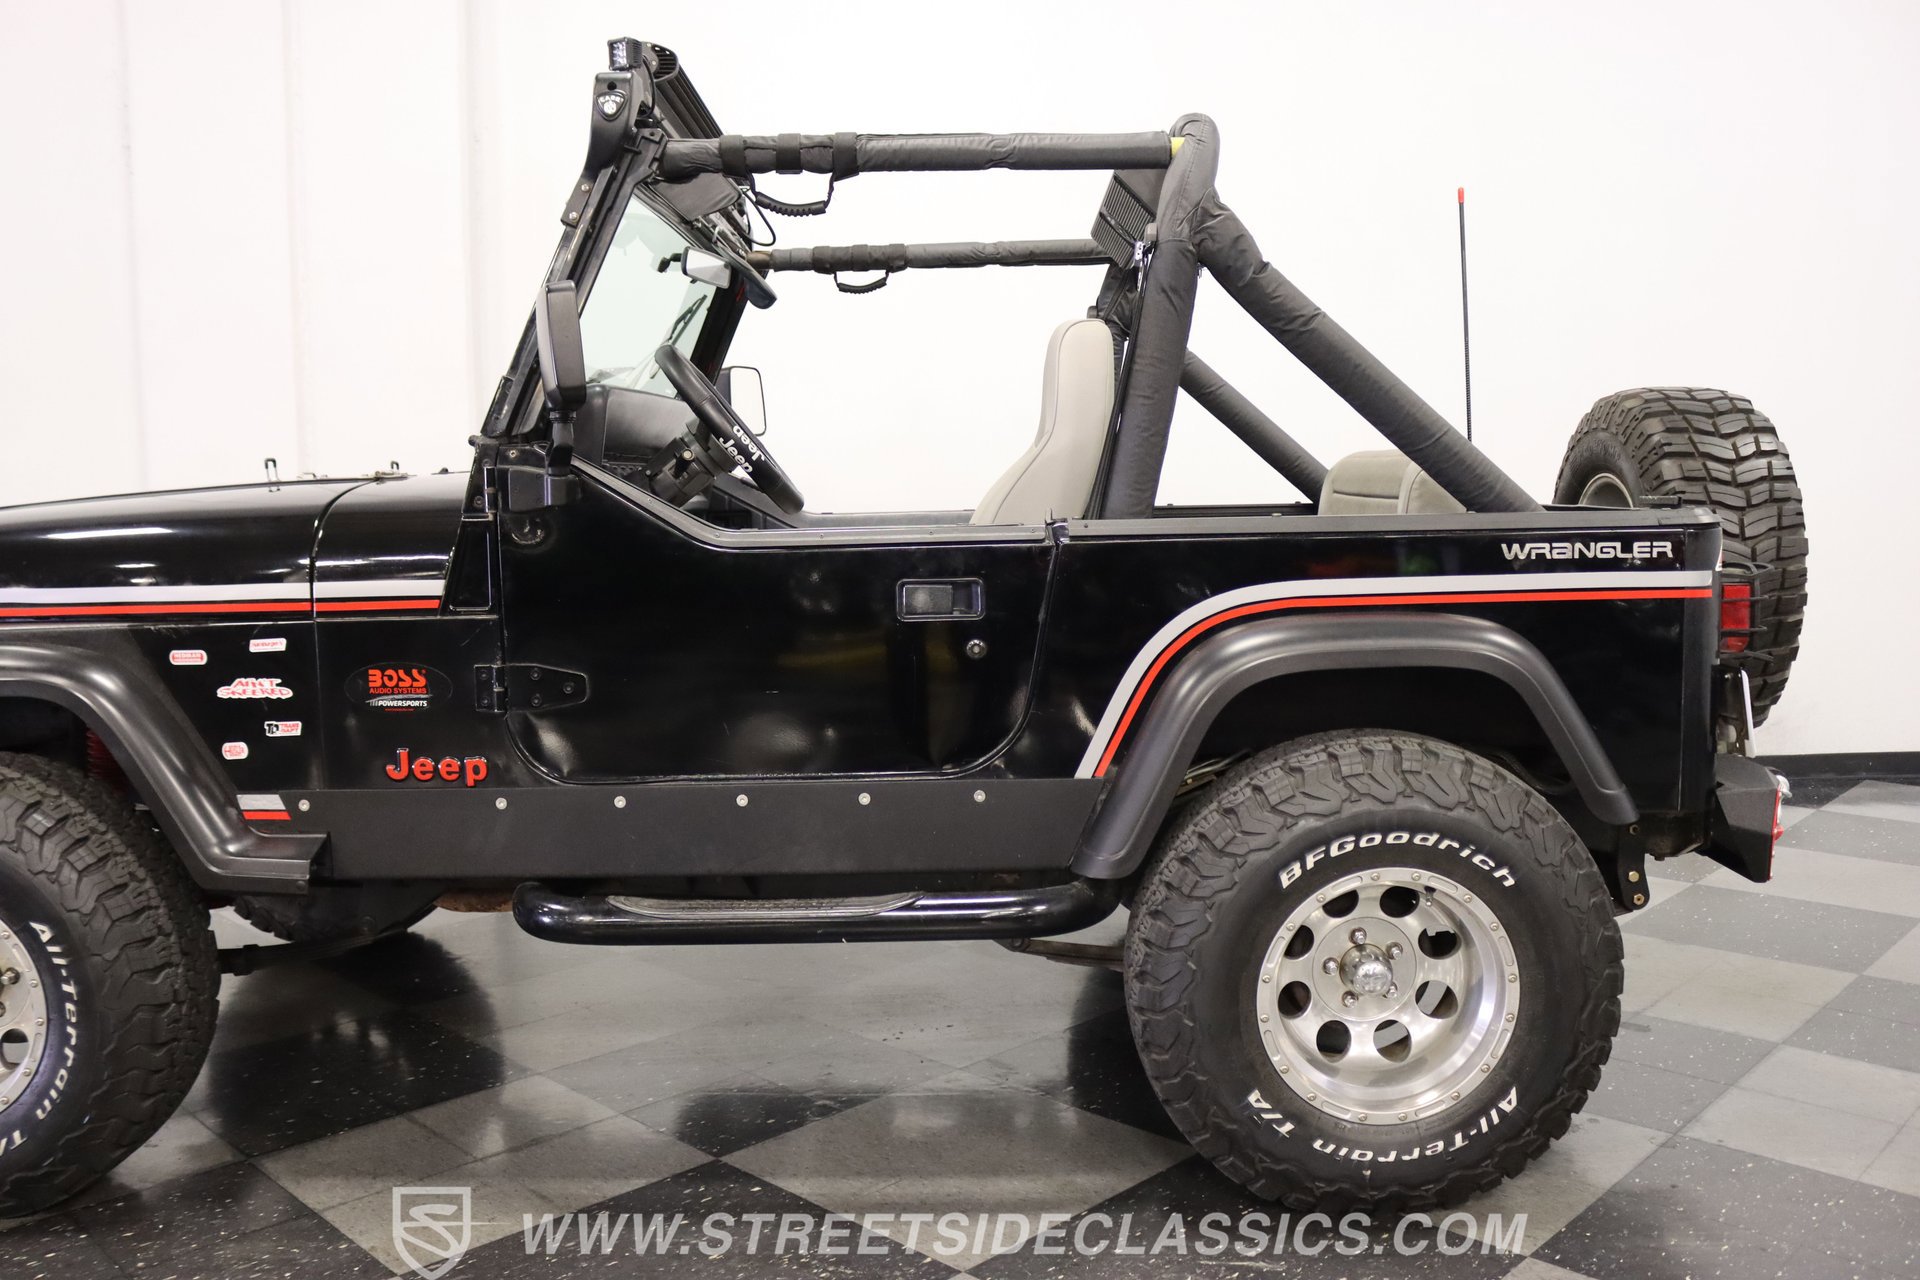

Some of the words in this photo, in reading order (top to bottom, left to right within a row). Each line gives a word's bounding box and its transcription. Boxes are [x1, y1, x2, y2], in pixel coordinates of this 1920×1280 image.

[719, 437, 753, 473] Jeep
[733, 425, 765, 461] Jeep
[368, 669, 427, 688] BOSS
[386, 748, 488, 787] Jeep
[1278, 830, 1516, 889] BFGoodrich
[29, 921, 78, 1120] All-Terrain
[1248, 1088, 1297, 1138] T/A
[1312, 1086, 1518, 1163] All-Terrain
